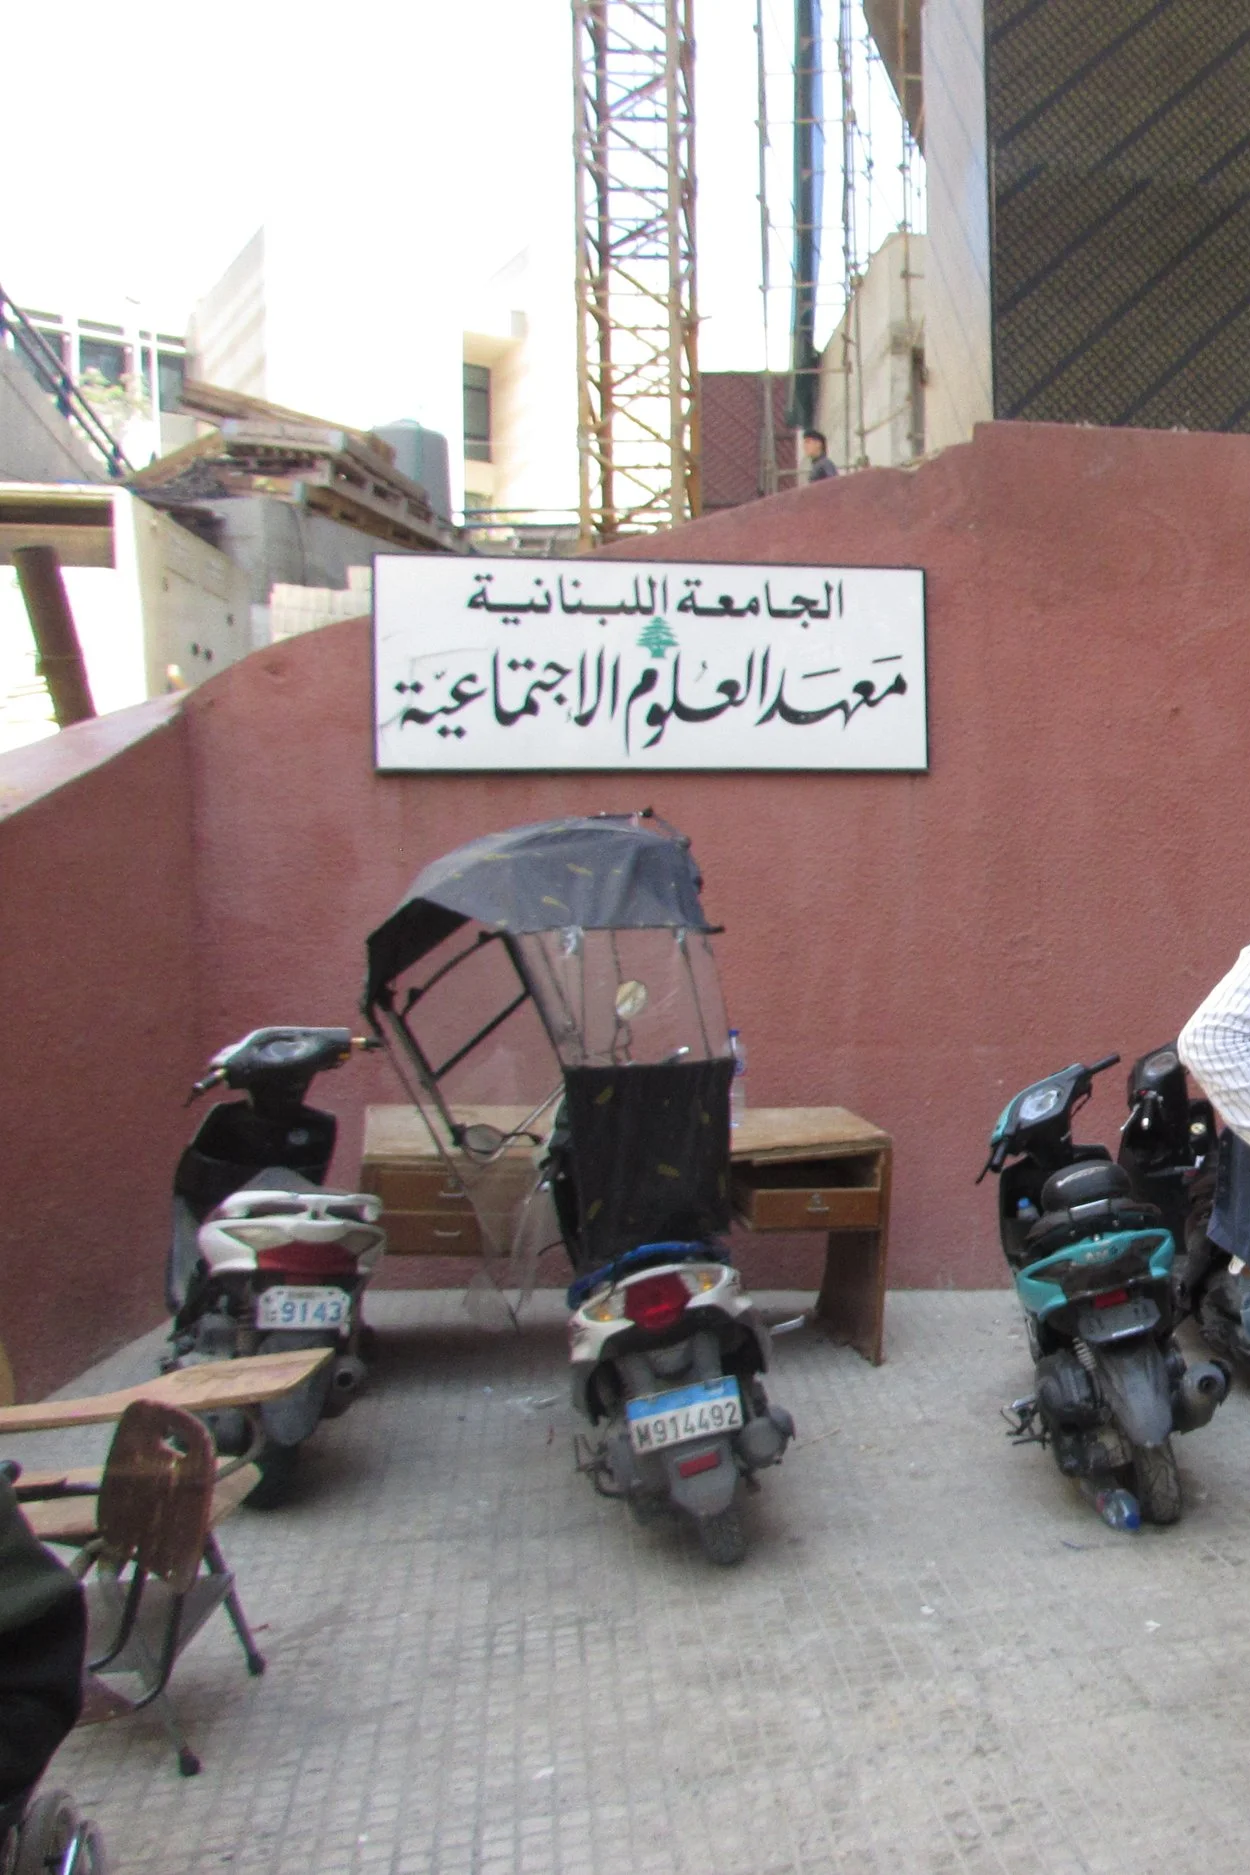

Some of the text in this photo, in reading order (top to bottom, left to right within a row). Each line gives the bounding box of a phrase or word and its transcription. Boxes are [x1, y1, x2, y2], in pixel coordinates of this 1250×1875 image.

[466, 573, 845, 629] الجامعة اللبنانية
[281, 1301, 342, 1322] 9143
[635, 1400, 740, 1448] M914492
